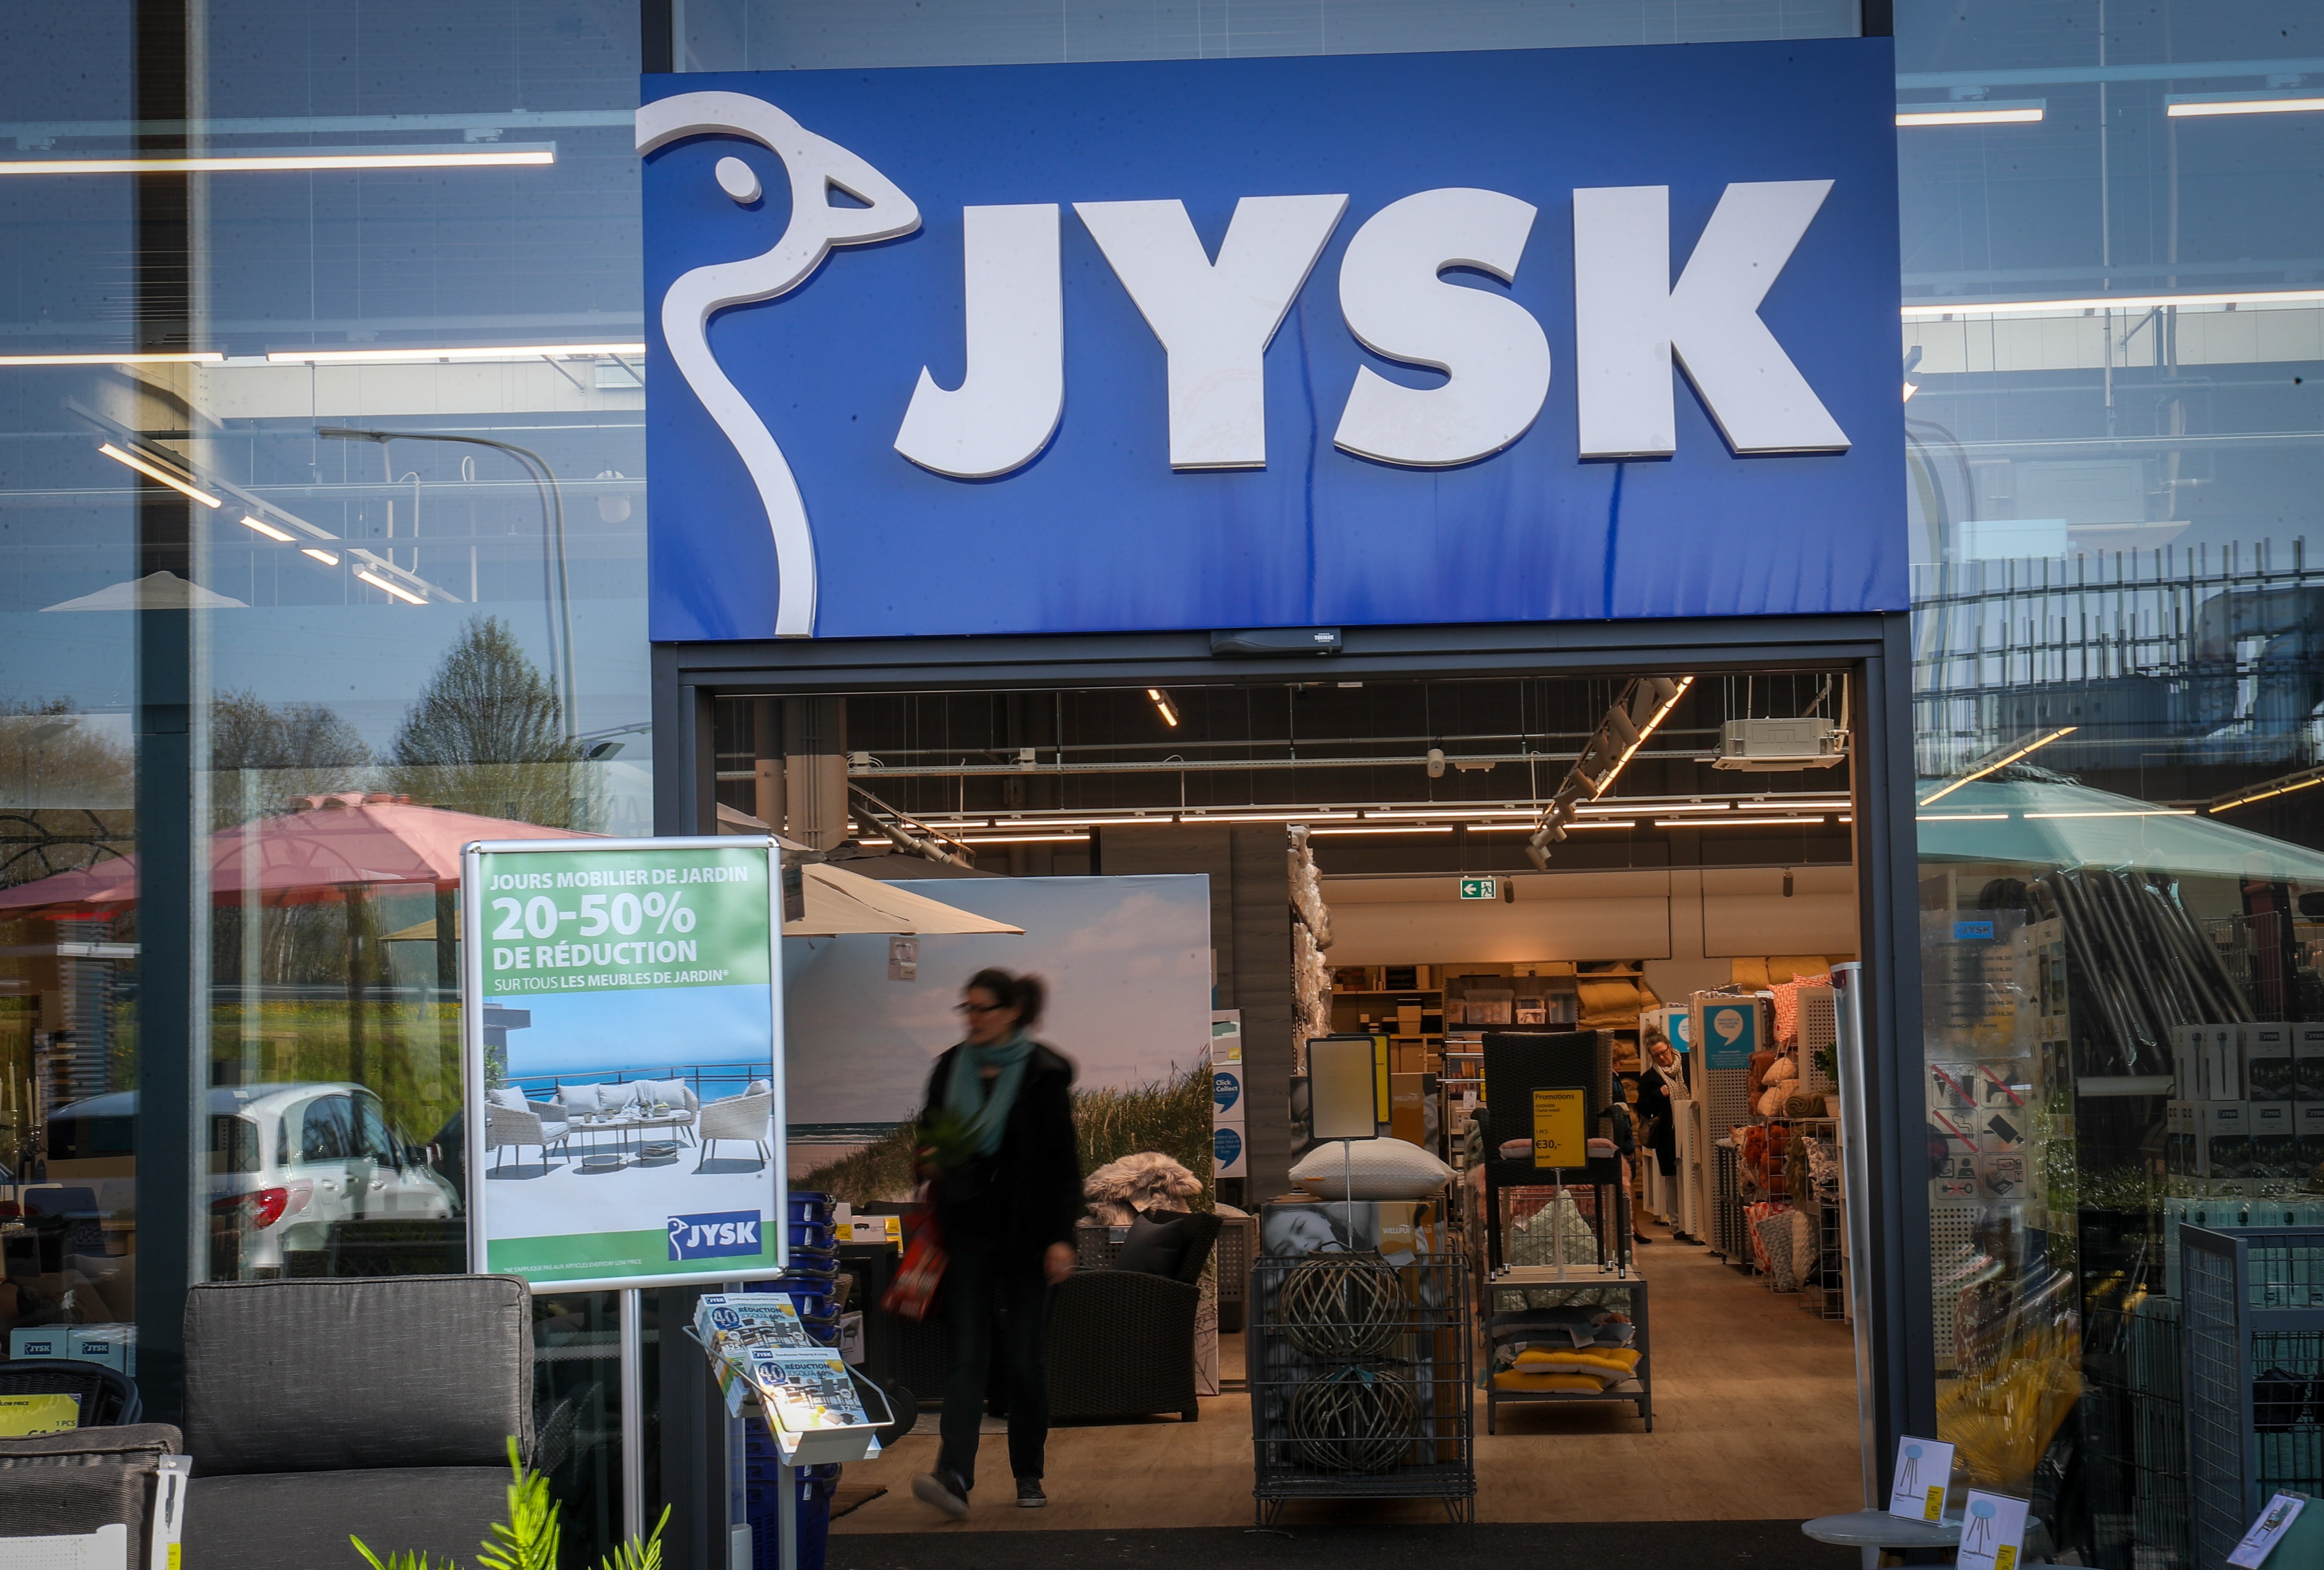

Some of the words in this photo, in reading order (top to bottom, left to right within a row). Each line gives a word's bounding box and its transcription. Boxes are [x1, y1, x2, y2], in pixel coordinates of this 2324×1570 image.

[893, 179, 1852, 480] JYSK
[490, 872, 553, 891] JOURS
[557, 869, 647, 889] MOBILIER
[652, 868, 676, 885] DE
[680, 866, 748, 885] JARDIN
[492, 891, 697, 940] 20-50%
[493, 946, 531, 970] DE
[536, 940, 697, 968] RÉDUCTION
[494, 978, 521, 991] SUR
[524, 977, 559, 990] TOUS
[561, 975, 585, 988] LES
[588, 973, 651, 987] MEUBLES
[653, 972, 672, 984] DE
[1536, 1140, 1561, 1150] €30,-
[686, 1221, 757, 1248] JYSK
